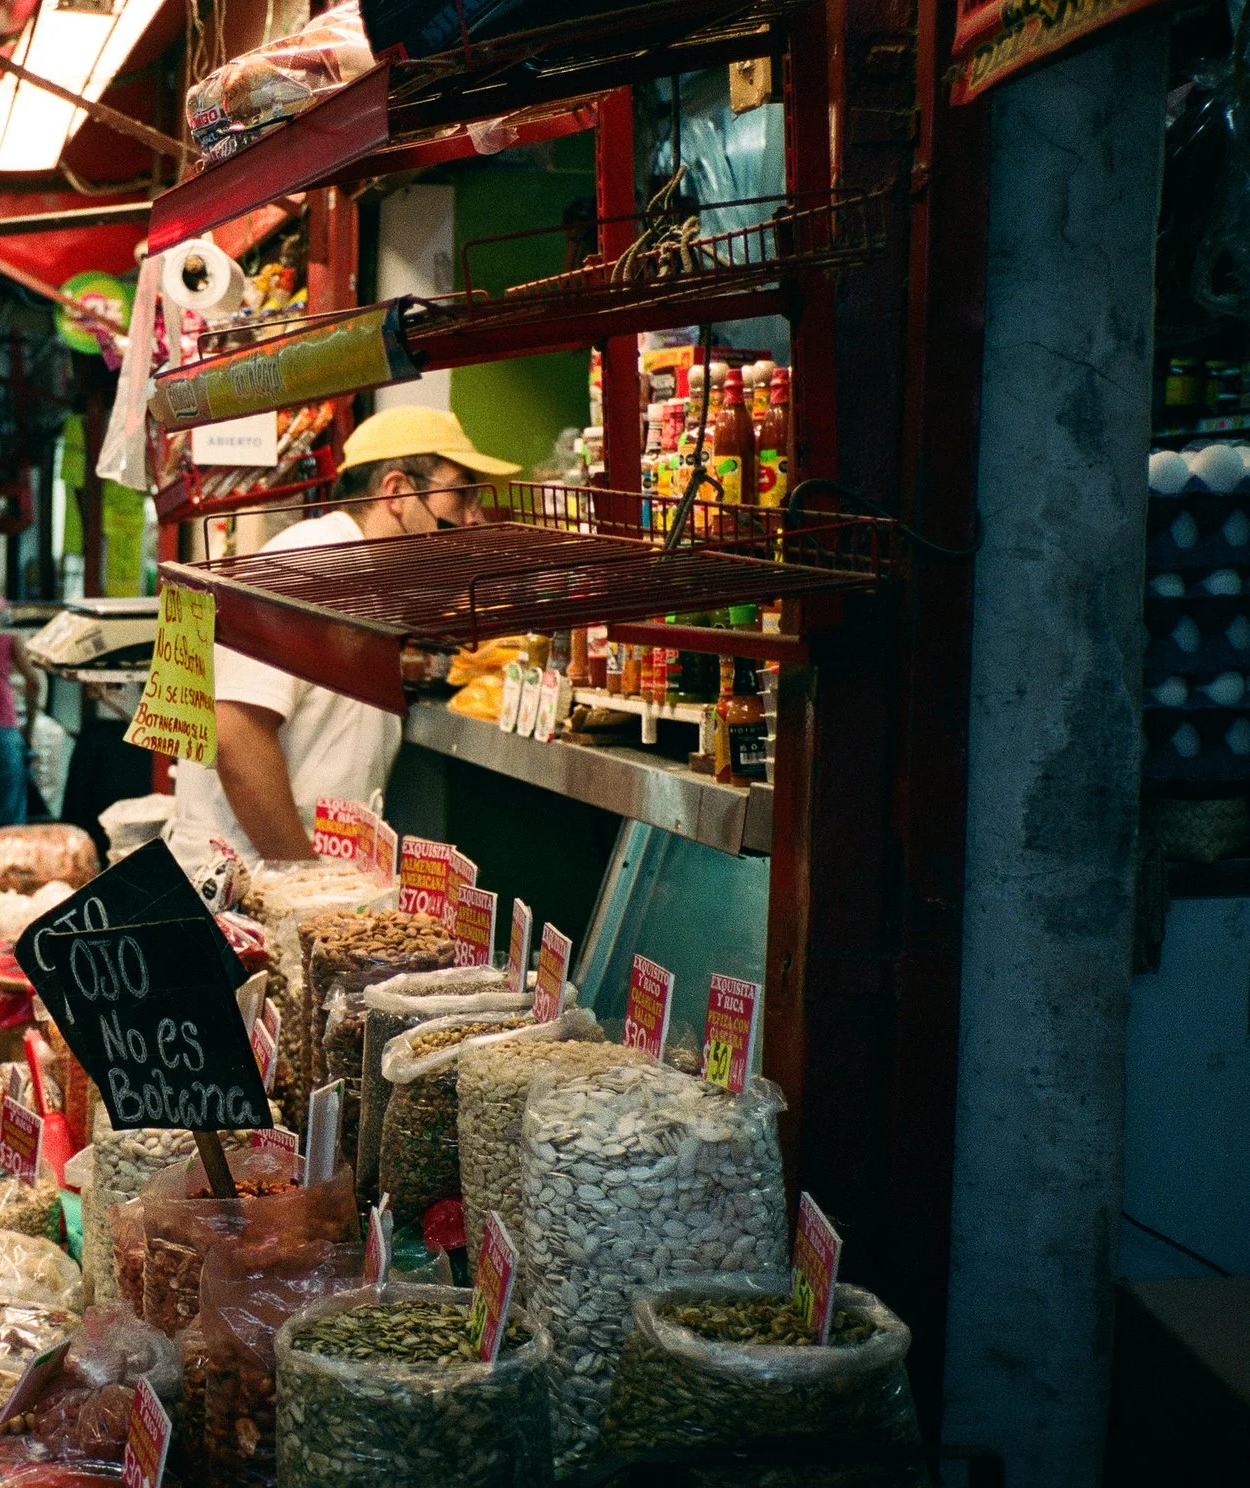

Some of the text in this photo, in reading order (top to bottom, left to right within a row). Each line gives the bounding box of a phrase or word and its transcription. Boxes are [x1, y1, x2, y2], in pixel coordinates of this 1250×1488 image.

[312, 832, 354, 859] $100
[402, 841, 451, 860] EXQUISITA
[398, 885, 429, 913] $70
[458, 887, 493, 909] EXQUISITA
[453, 937, 476, 967] $85
[70, 935, 150, 1001] OJO
[633, 955, 669, 986] EXQUISITO
[644, 978, 661, 998] RICO
[710, 975, 755, 1000] EXQUISITA
[723, 995, 745, 1014] RICA
[100, 1009, 148, 1063] No
[157, 1017, 205, 1072] es
[623, 1016, 647, 1052] $30
[108, 1067, 262, 1128] Botana
